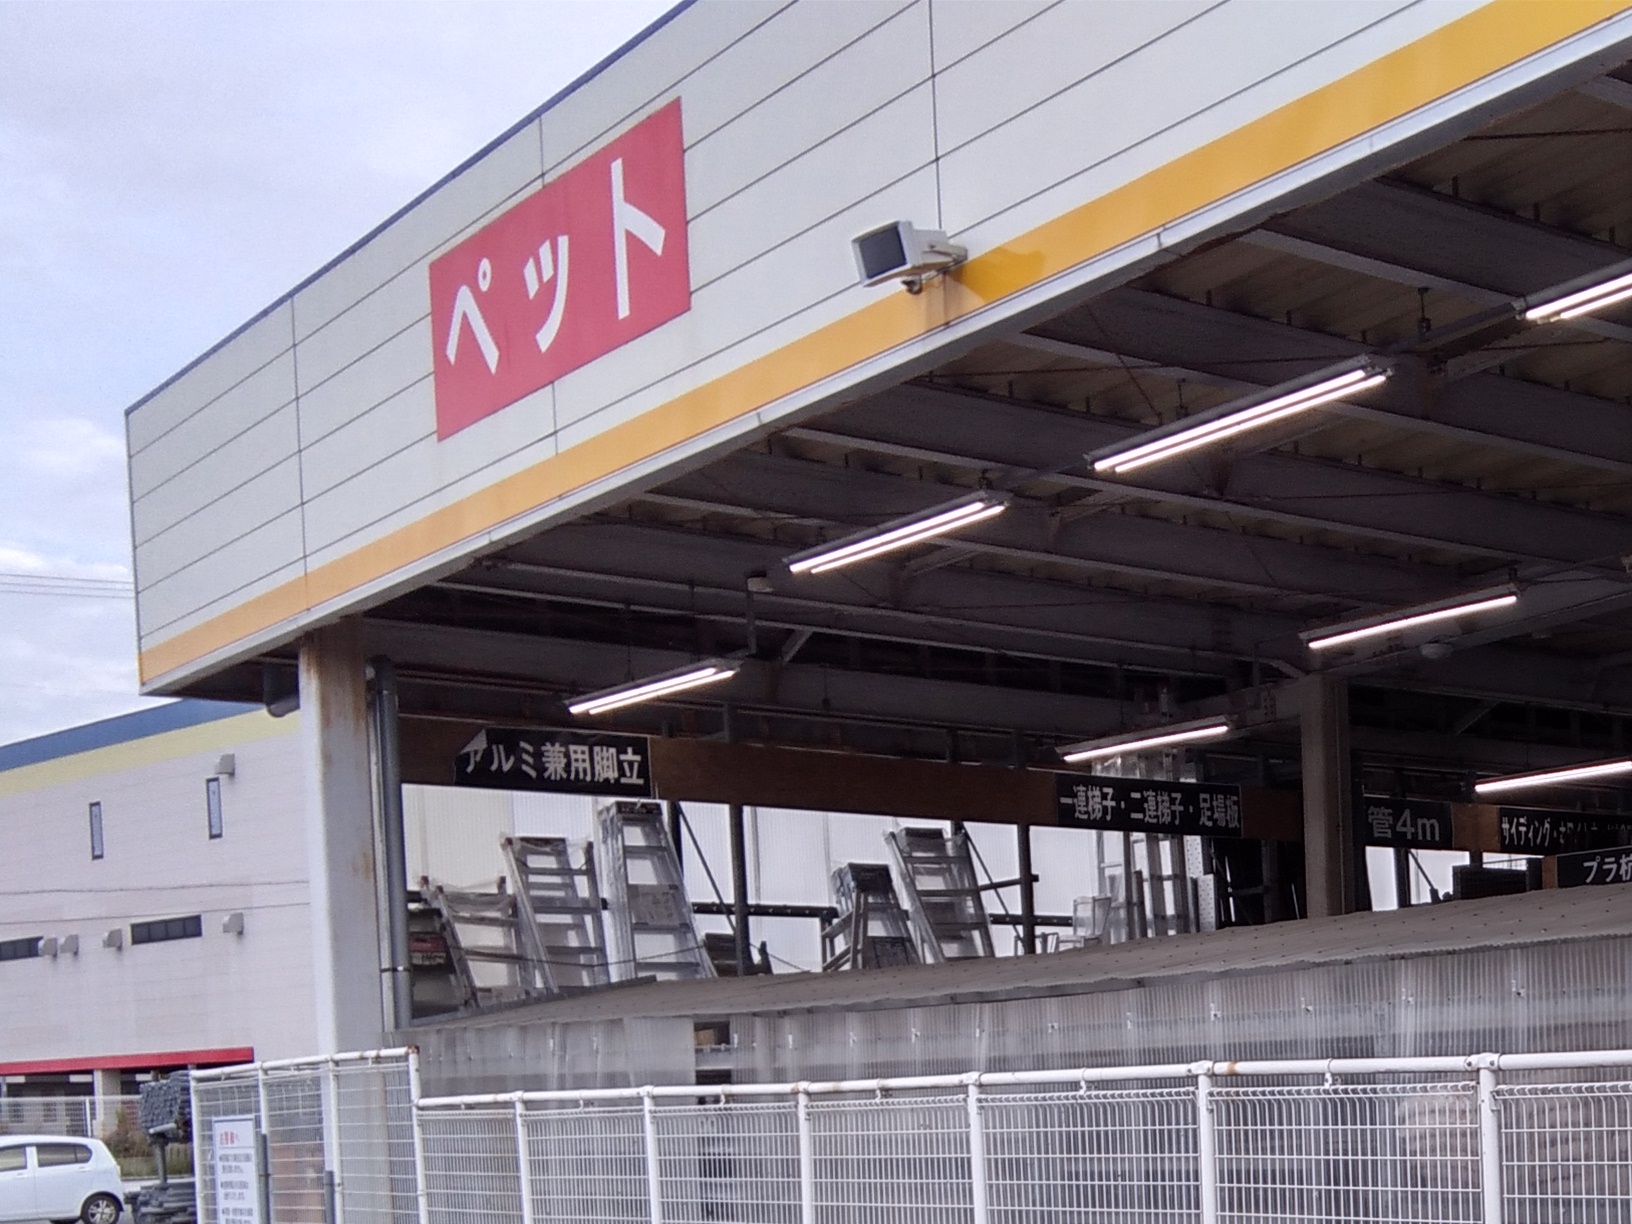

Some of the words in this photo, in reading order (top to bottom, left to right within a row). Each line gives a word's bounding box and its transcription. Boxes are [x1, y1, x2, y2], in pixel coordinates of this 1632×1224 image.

[446, 157, 666, 375] ペット
[462, 740, 645, 785] アルミ兼用脚立
